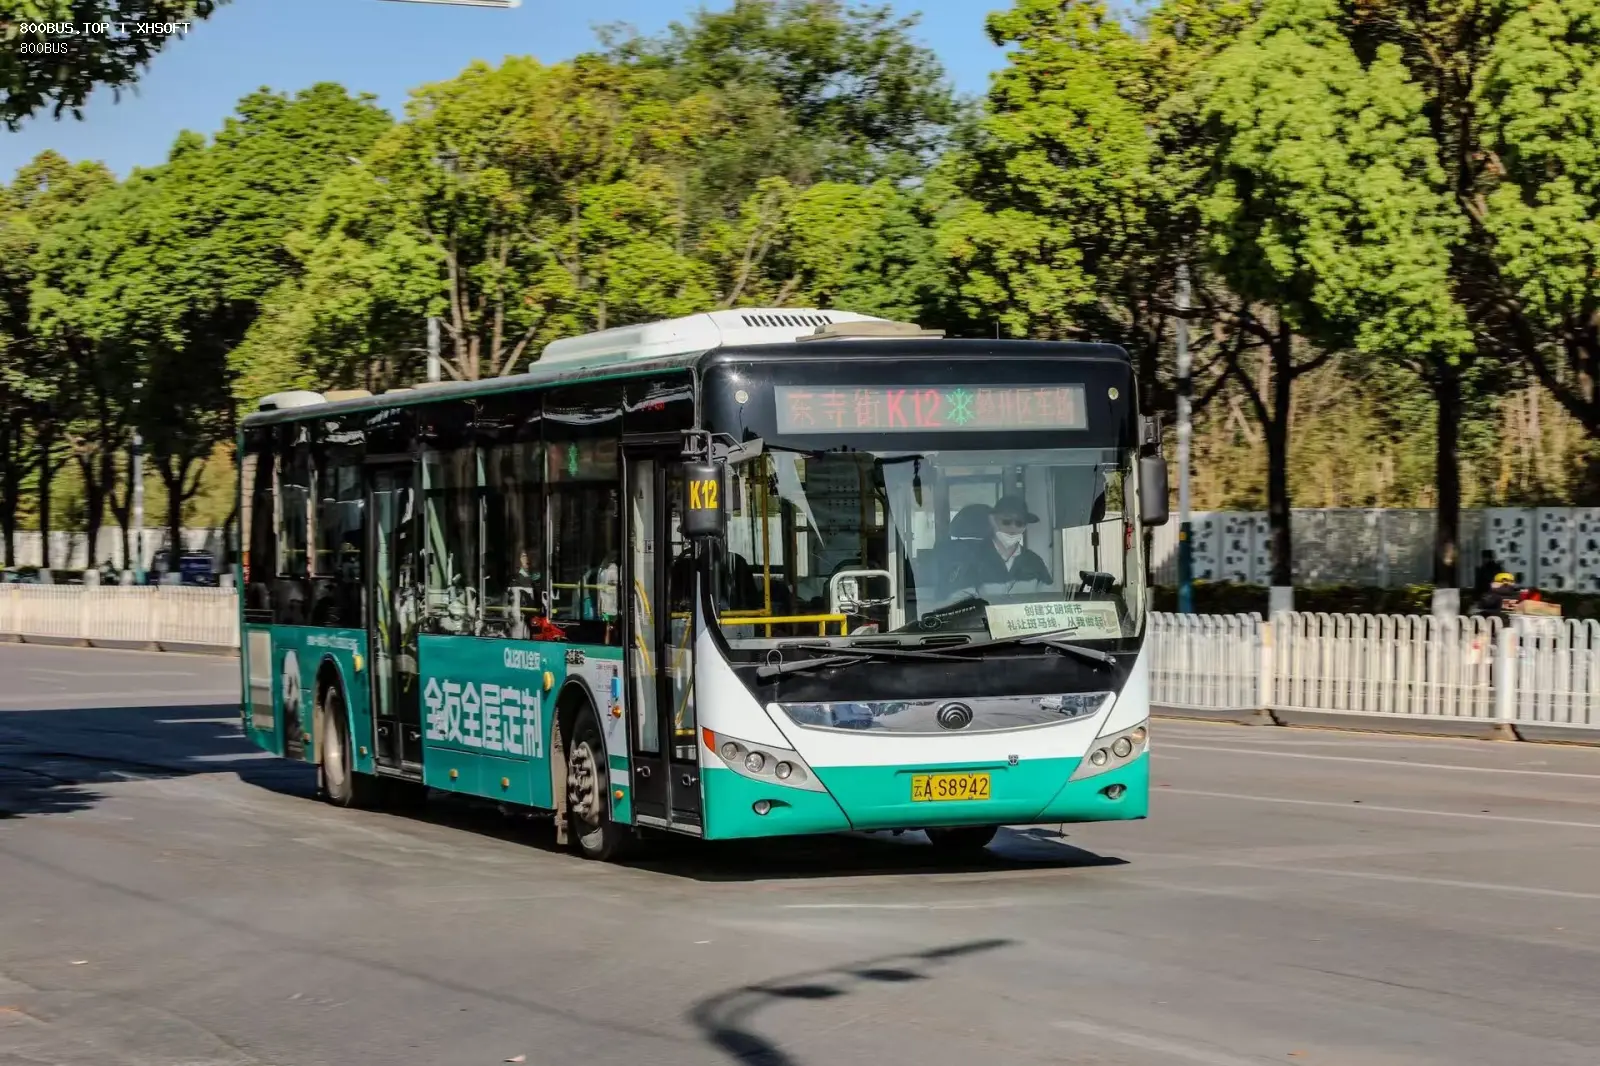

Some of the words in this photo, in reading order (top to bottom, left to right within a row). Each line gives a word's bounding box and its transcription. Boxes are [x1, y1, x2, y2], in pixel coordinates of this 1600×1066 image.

[886, 388, 942, 428] K12
[689, 479, 718, 510] K12
[1023, 603, 1083, 616] 创建文明城市
